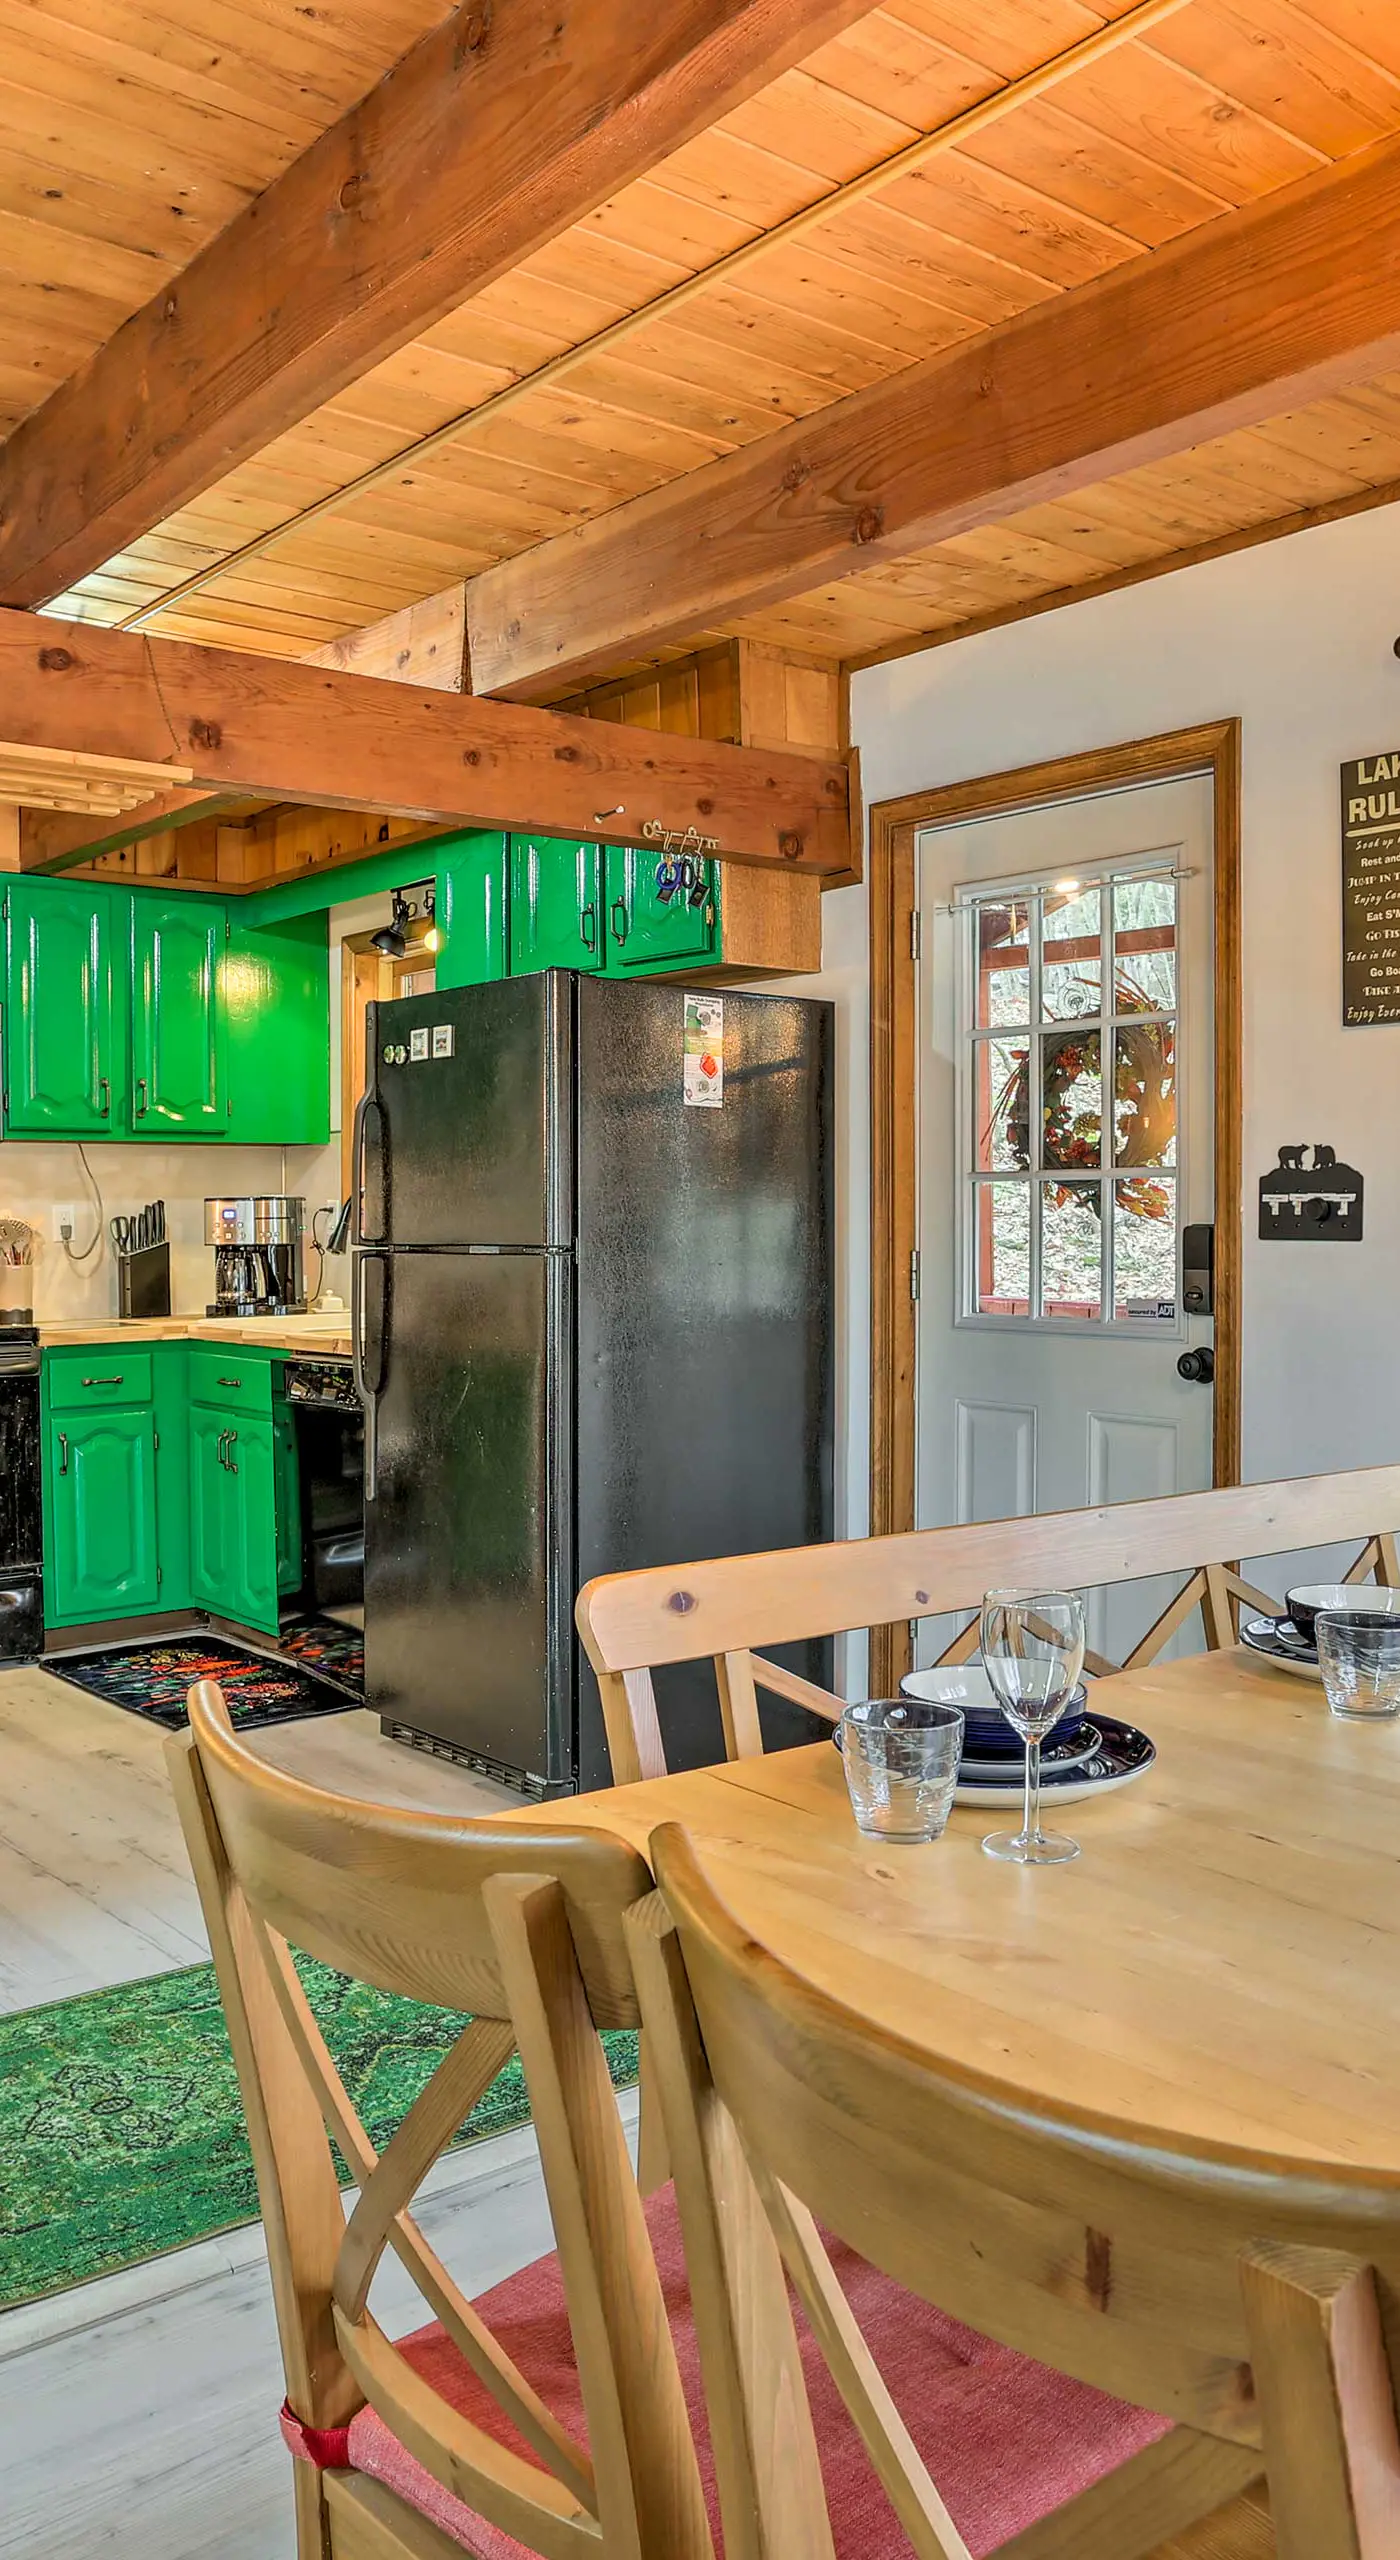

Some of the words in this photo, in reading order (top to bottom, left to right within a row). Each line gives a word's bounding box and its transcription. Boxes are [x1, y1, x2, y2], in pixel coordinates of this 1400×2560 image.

[1348, 791, 1400, 823] RUL
[1355, 838, 1380, 850] Soak
[1382, 838, 1394, 849] up
[1361, 856, 1382, 867] Rest
[1347, 875, 1377, 888] JUMP
[1379, 873, 1391, 882] IN
[1354, 893, 1382, 906] Enjoy
[1366, 911, 1383, 921] Eat
[1346, 951, 1367, 962] Take
[1369, 950, 1379, 960] in
[1381, 948, 1397, 958] the
[1370, 967, 1383, 977] Go
[1362, 985, 1391, 996] TAKE
[1347, 1006, 1375, 1023] Enjoy
[1158, 1305, 1174, 1316] ADT
